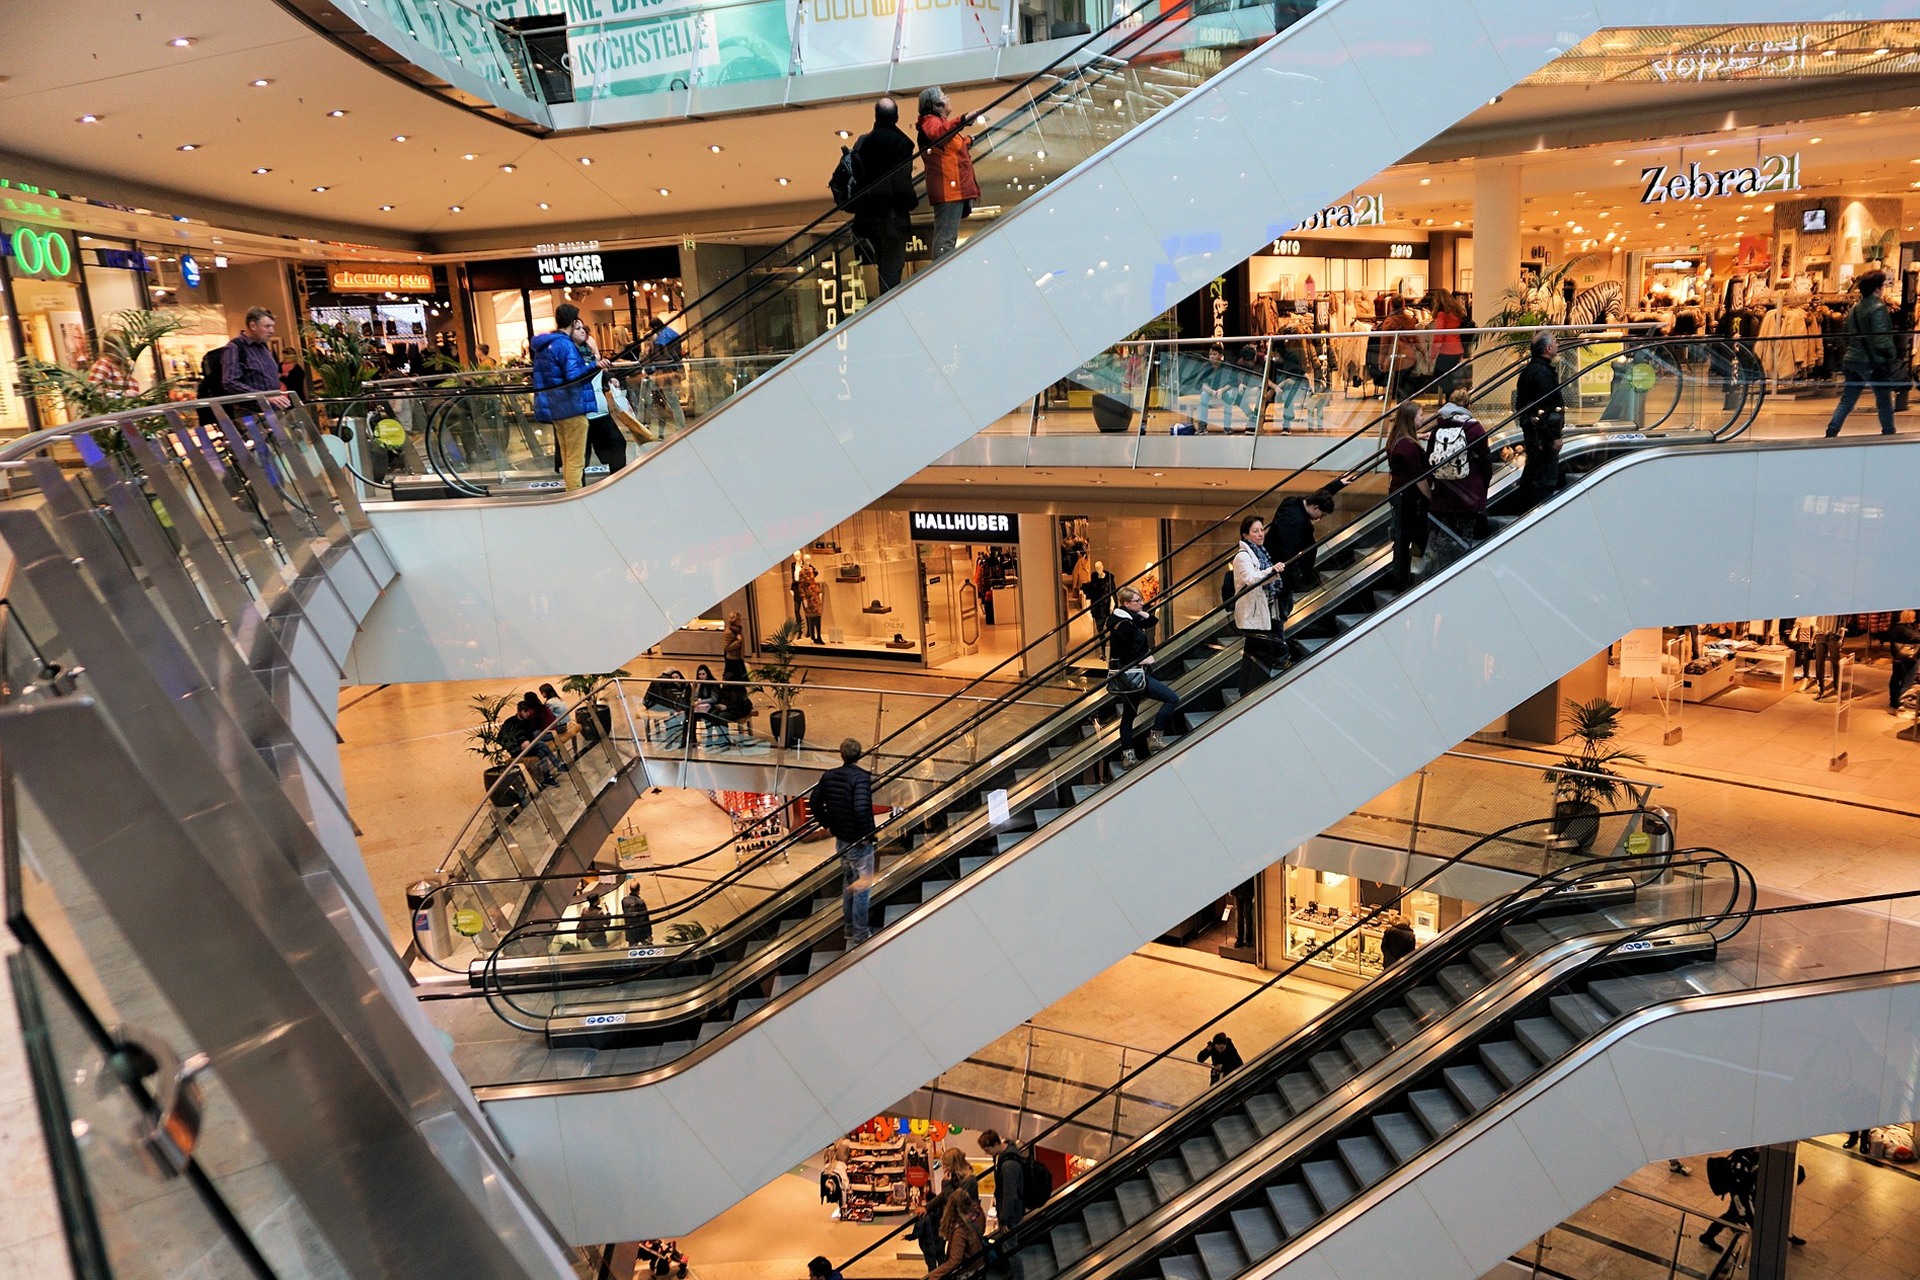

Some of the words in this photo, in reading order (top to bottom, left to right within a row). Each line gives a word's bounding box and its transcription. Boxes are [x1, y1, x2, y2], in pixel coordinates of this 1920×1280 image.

[1640, 152, 1801, 204] Zebra21
[905, 235, 928, 252] ch.
[1273, 239, 1301, 256] zero
[1390, 244, 1413, 259] zero
[538, 254, 603, 274] HILFIGER
[564, 268, 605, 285] DENIM
[915, 512, 1010, 532] HALLHUBER
